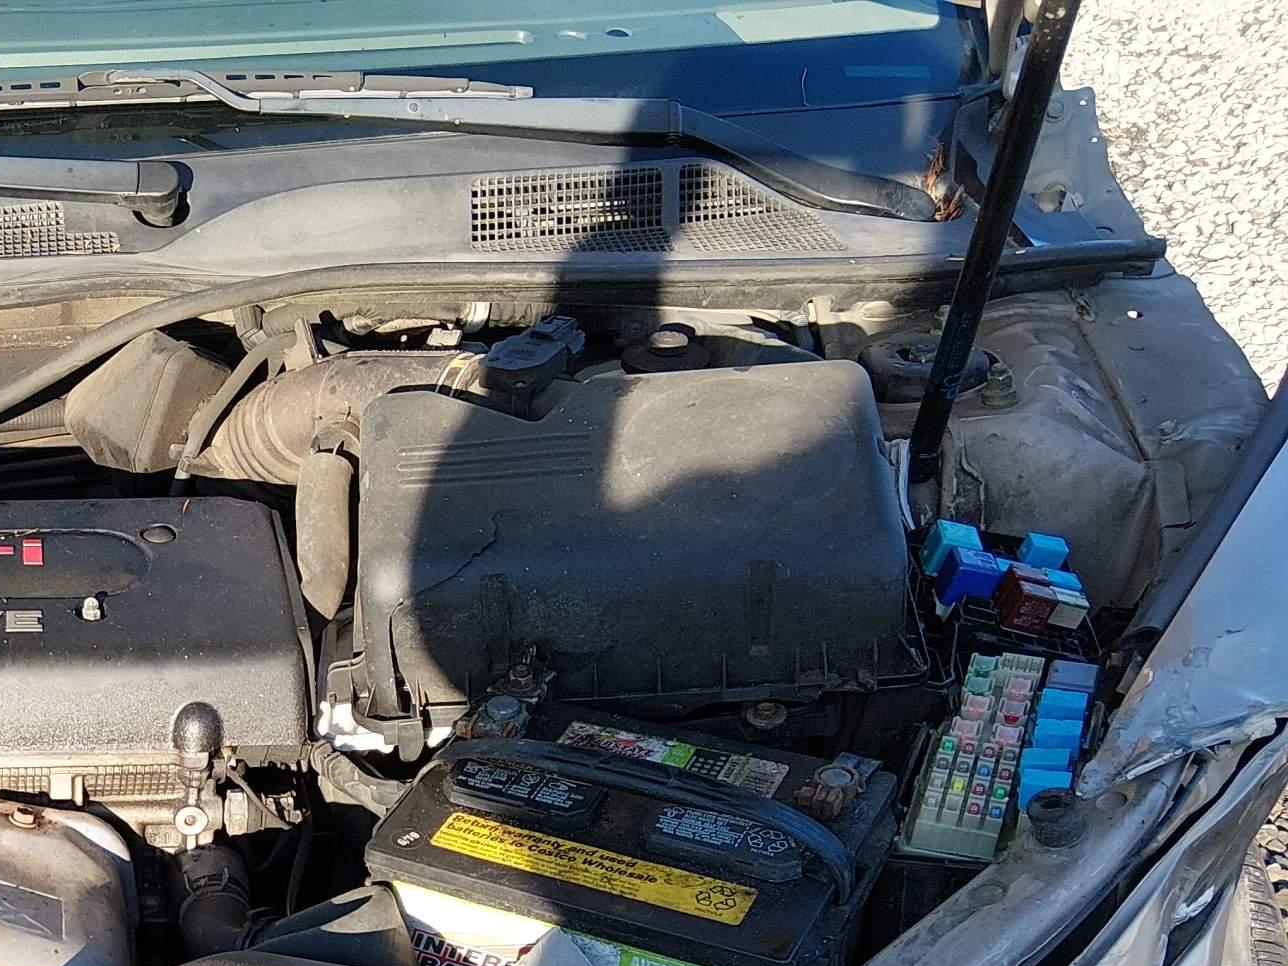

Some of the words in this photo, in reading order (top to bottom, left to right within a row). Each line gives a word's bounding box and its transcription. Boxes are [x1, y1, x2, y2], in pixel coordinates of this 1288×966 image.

[446, 822, 506, 844] batteries
[527, 844, 577, 863] Costco
[580, 857, 659, 884] Wholesale
[451, 815, 498, 833] Return
[501, 828, 566, 851] warranty
[568, 845, 597, 858] and
[598, 853, 638, 868] used
